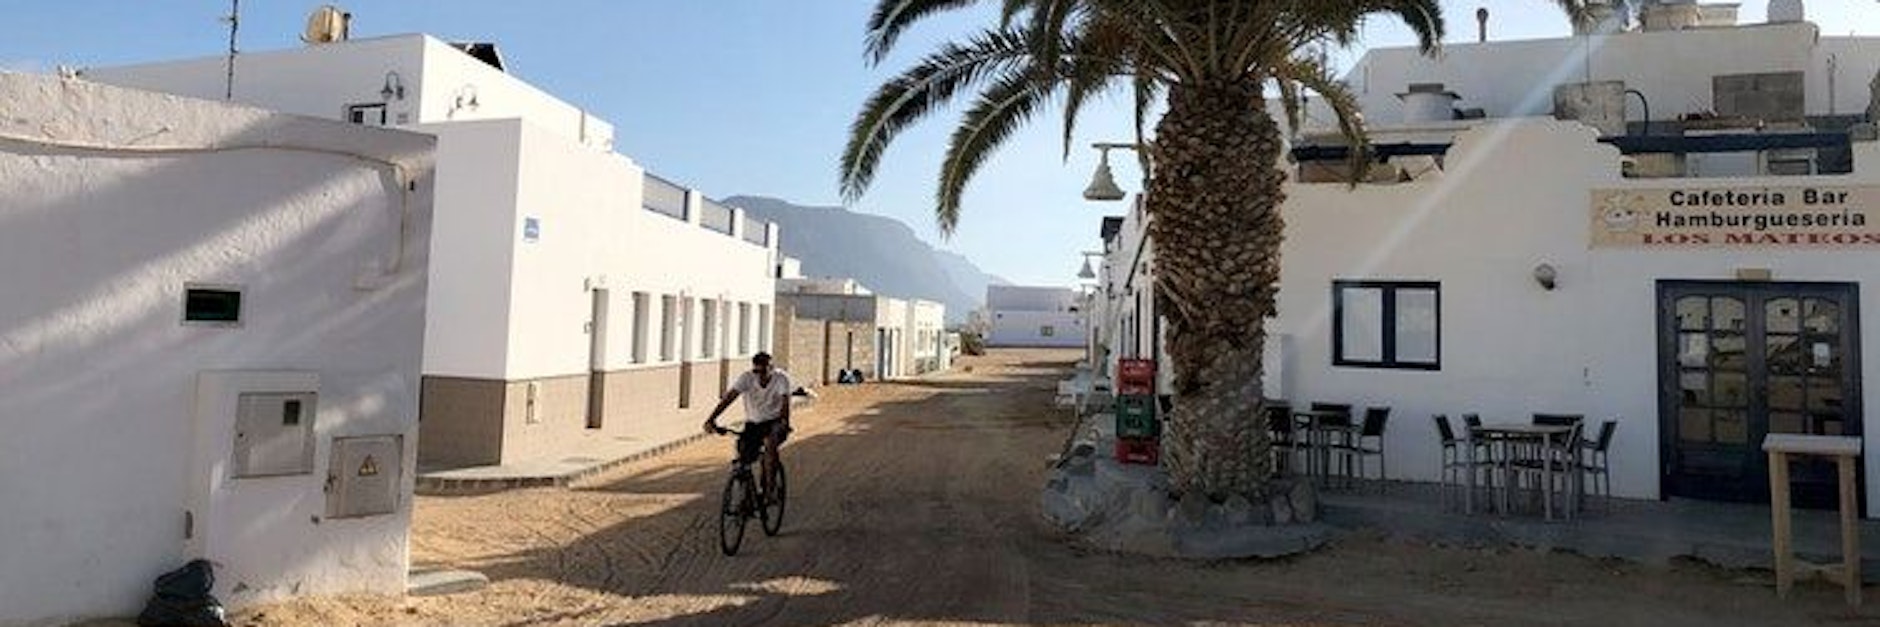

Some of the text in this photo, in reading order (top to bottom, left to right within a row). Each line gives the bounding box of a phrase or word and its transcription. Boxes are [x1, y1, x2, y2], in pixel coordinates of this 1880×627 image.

[1803, 188, 1848, 204] Bar
[1643, 232, 1880, 244] LOS MATEOS
